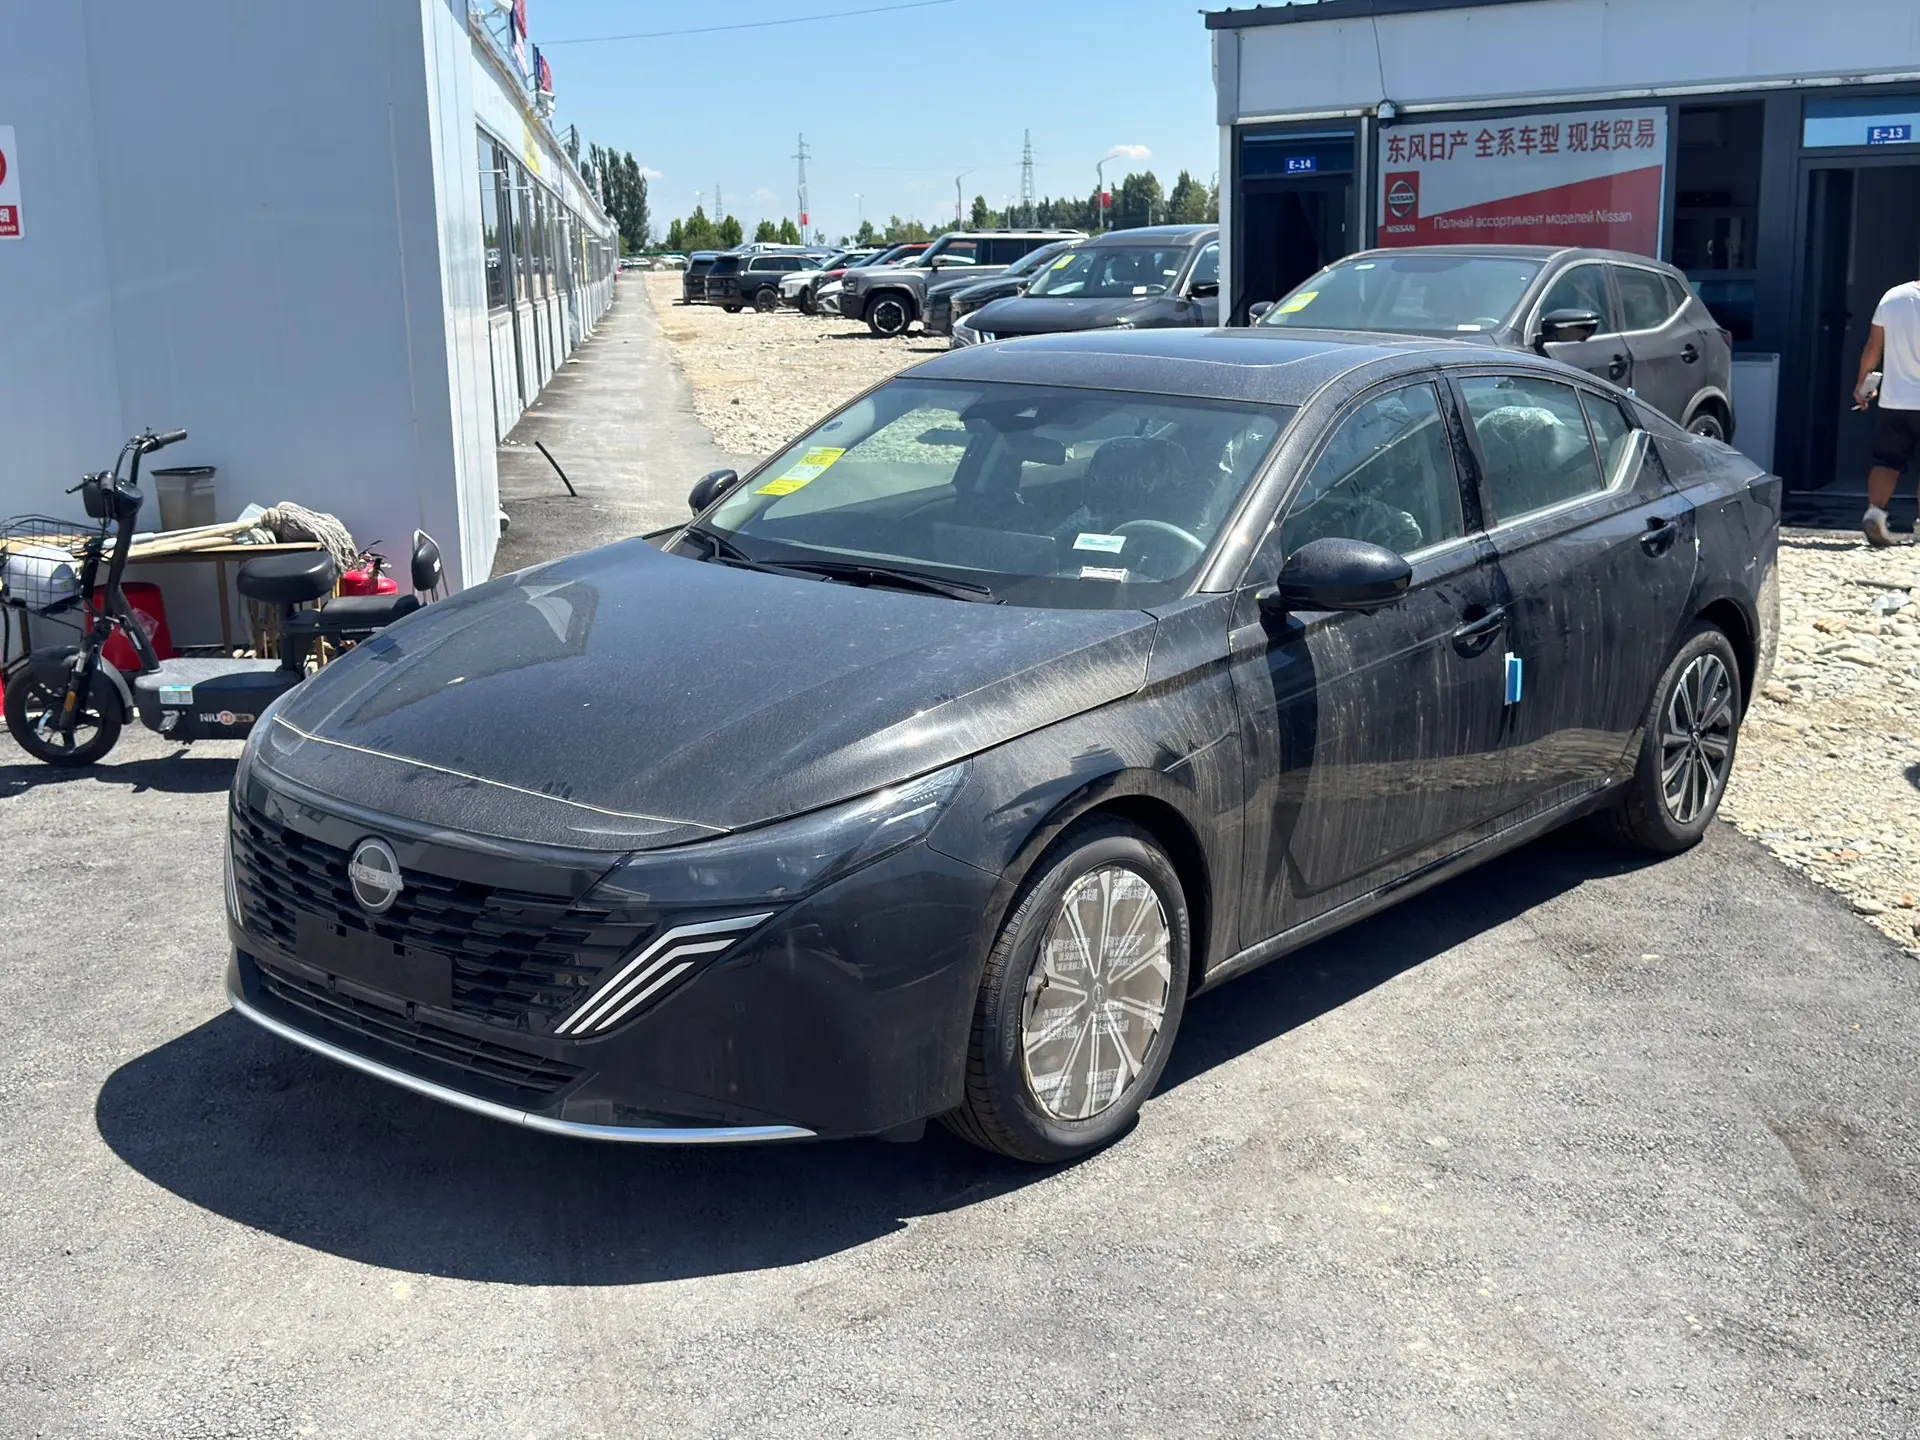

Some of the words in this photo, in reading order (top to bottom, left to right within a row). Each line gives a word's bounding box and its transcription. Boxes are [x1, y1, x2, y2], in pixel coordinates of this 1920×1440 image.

[1873, 127, 1903, 139] E-13
[1387, 130, 1468, 163] 东风日产
[1475, 123, 1559, 158] 全系车型
[1567, 118, 1655, 153] 现货贸易
[1289, 159, 1311, 169] E-14
[1390, 194, 1414, 202] NISSAN
[1433, 215, 1473, 230] Полный
[1475, 214, 1544, 228] ассортимент
[1546, 210, 1594, 226] моделей
[1596, 209, 1632, 223] Nissan
[1386, 224, 1415, 233] NISSAN
[348, 862, 404, 891] NISSAN
